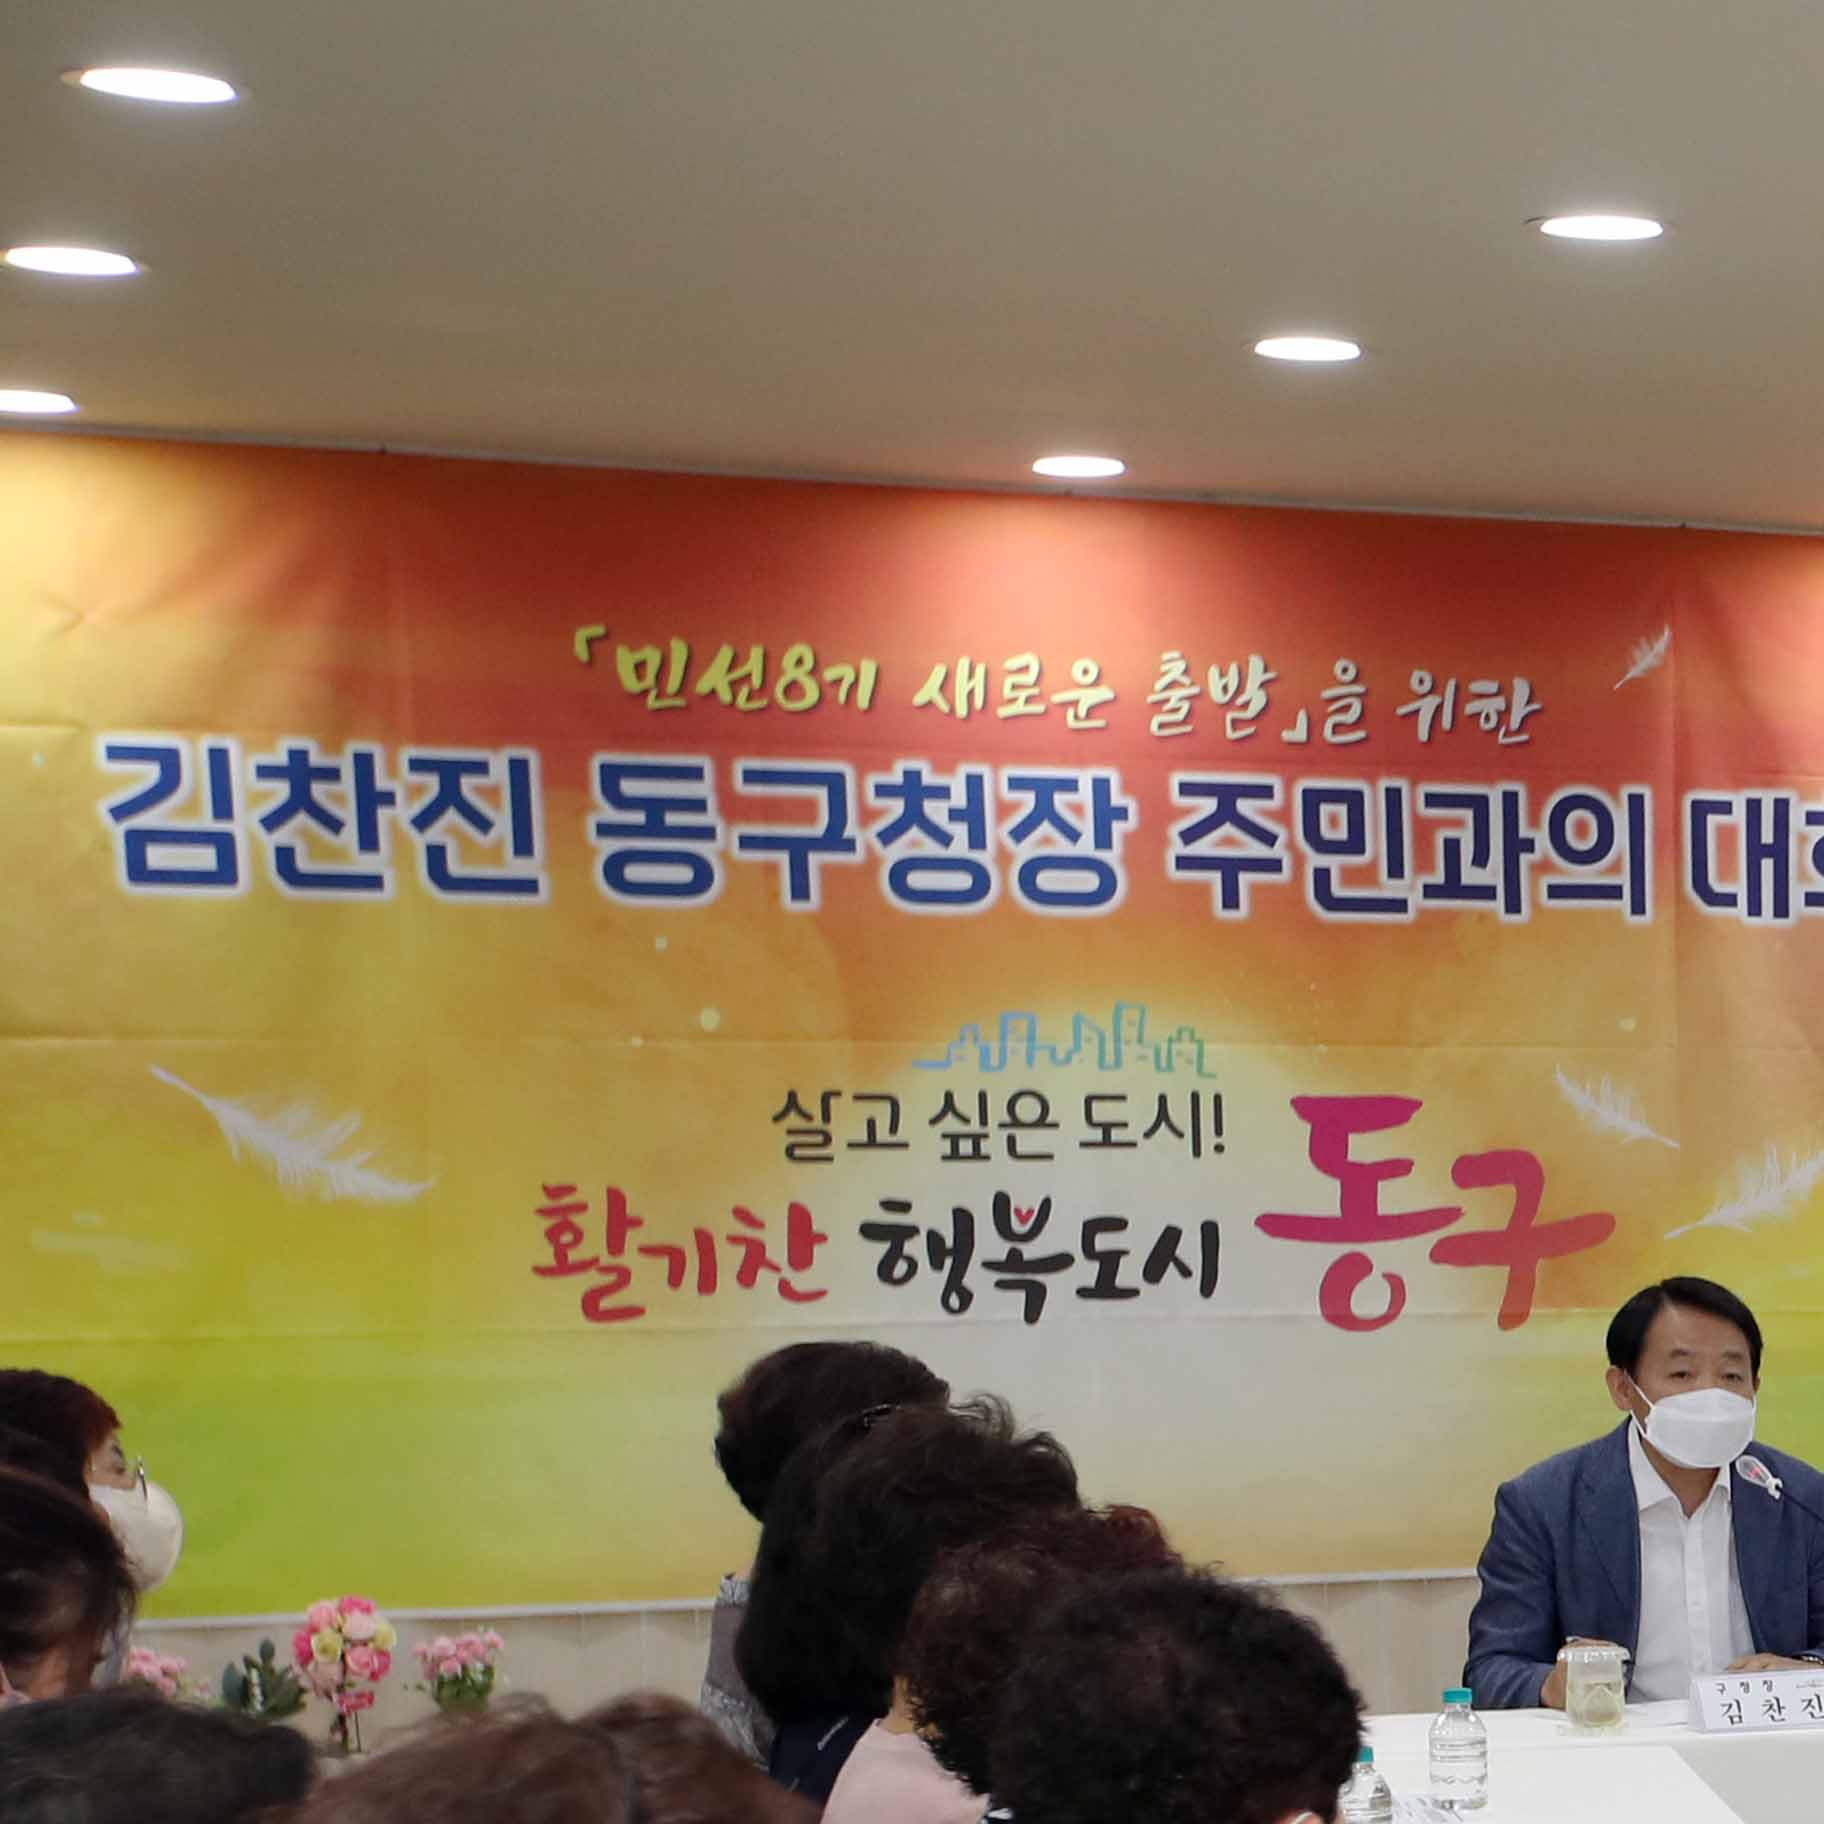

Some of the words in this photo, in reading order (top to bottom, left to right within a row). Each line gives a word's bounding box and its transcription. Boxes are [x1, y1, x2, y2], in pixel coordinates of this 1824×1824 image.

[573, 624, 879, 712] 「민선8기
[912, 652, 1115, 729] 새로운
[1147, 650, 1368, 744] 출발」을
[1396, 670, 1542, 744] 위한
[98, 738, 546, 901] 김찬진
[590, 758, 1132, 912] 동구청장
[1171, 777, 1648, 919] 주민과의
[771, 1090, 909, 1163] 살고
[928, 1090, 1060, 1161] 싶은
[1078, 1090, 1226, 1158] 도시!
[532, 1182, 828, 1323] 활기찬
[859, 1190, 1220, 1326] 행복도시
[1254, 1094, 1617, 1332] 동구
